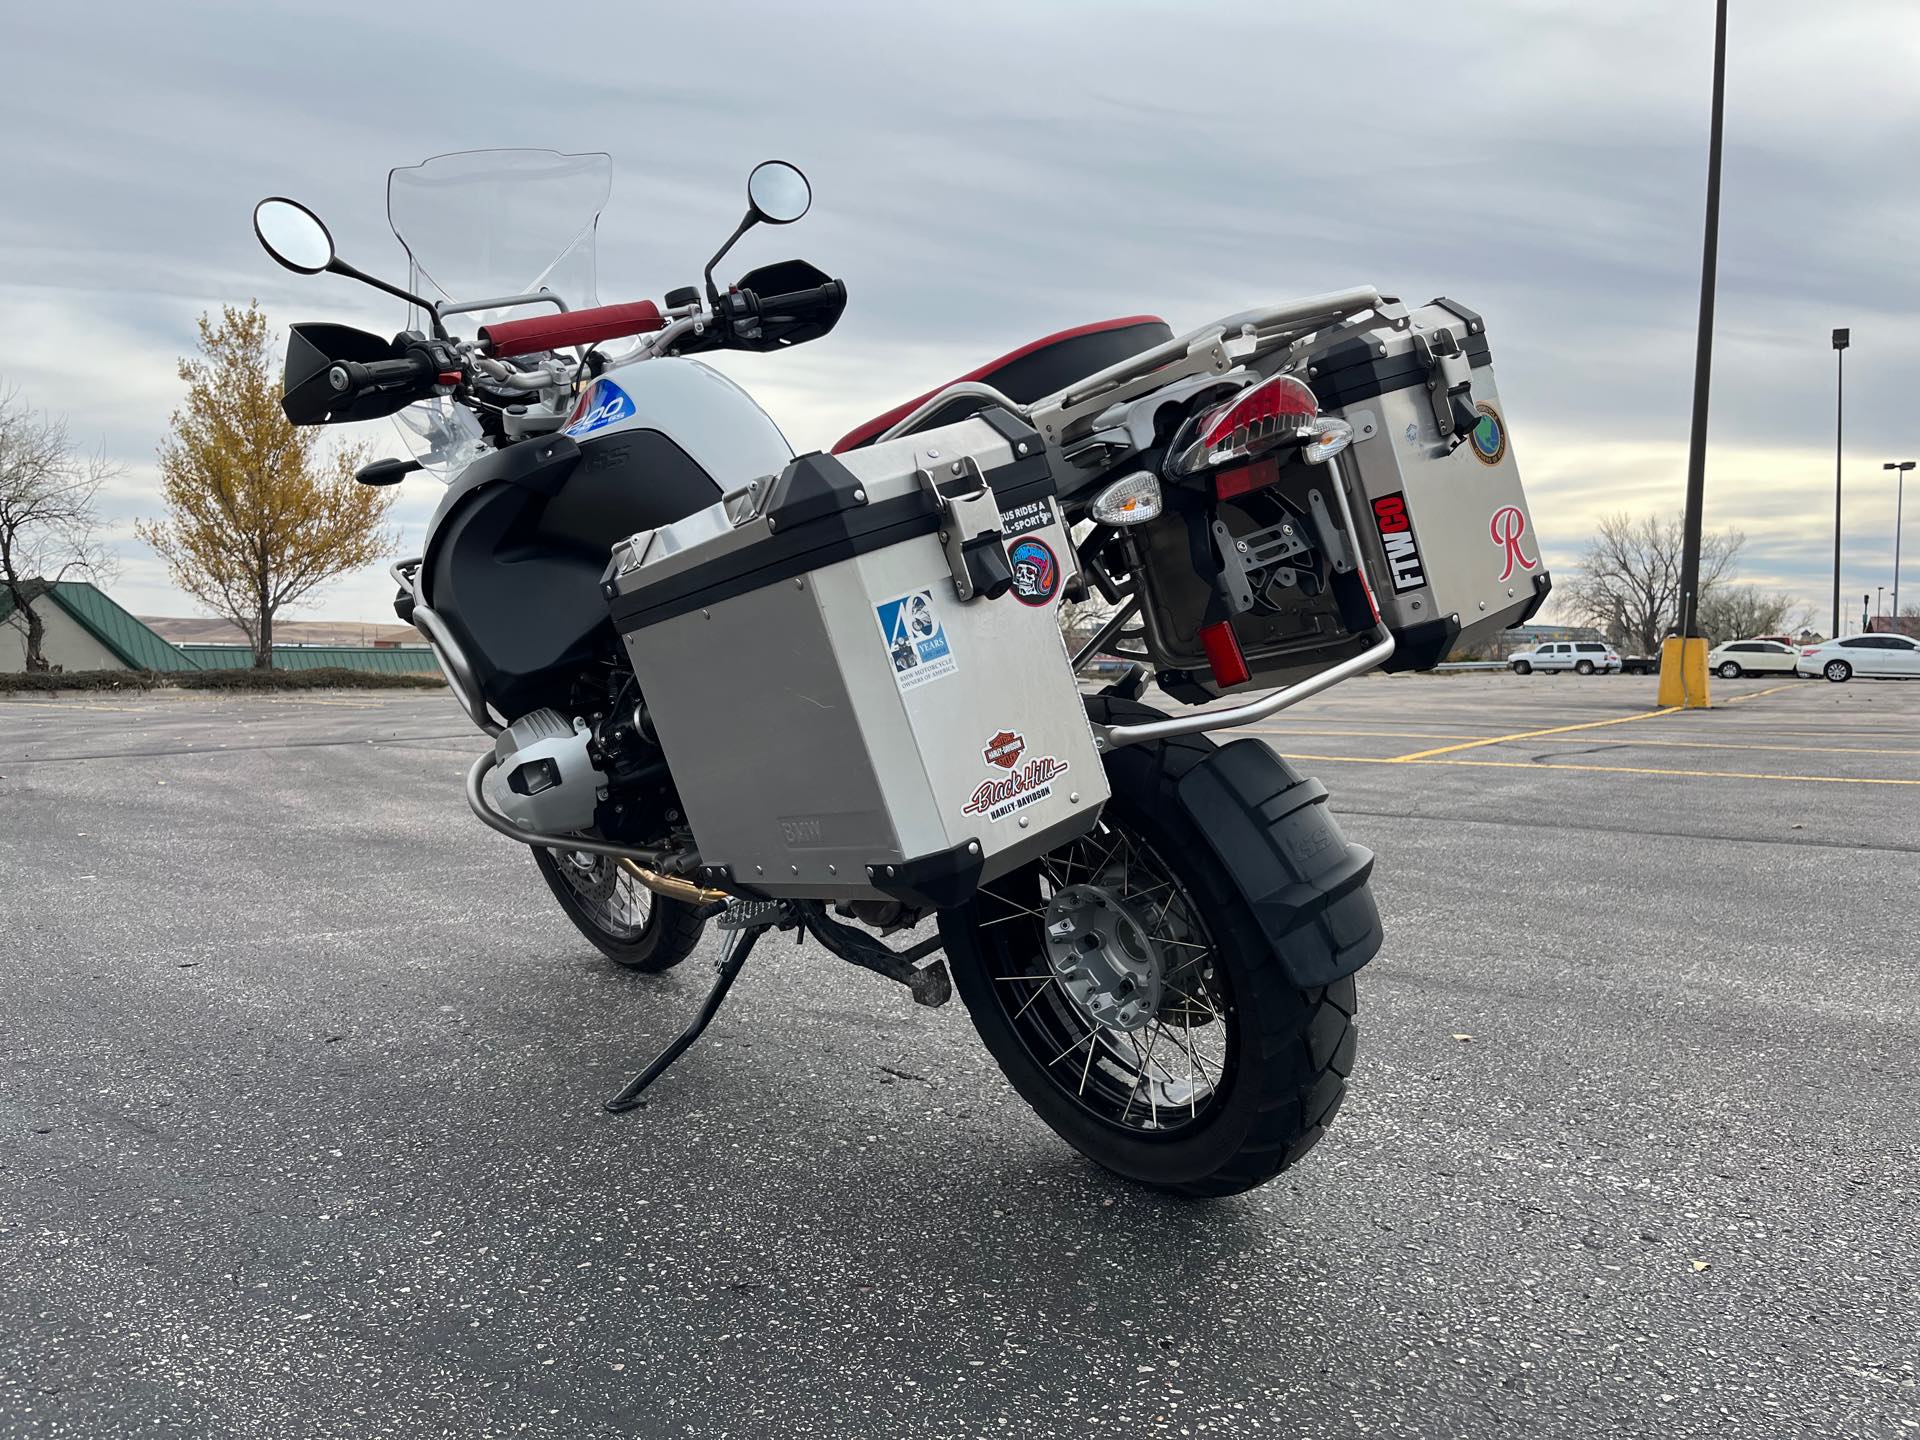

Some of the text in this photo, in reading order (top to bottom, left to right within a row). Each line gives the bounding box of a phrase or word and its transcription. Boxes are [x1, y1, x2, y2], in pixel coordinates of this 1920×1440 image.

[1014, 503, 1038, 519] RIDES
[1038, 500, 1046, 511] A
[1374, 496, 1425, 590] FTWCO
[1489, 506, 1537, 582] R
[918, 637, 945, 653] YEARS
[899, 657, 954, 683] BMW MOTORCYCLE
[901, 664, 957, 689] OWNERS OF AMERICA
[968, 770, 1024, 814] Black
[990, 785, 1051, 821] HARLEY-DAVIDSON
